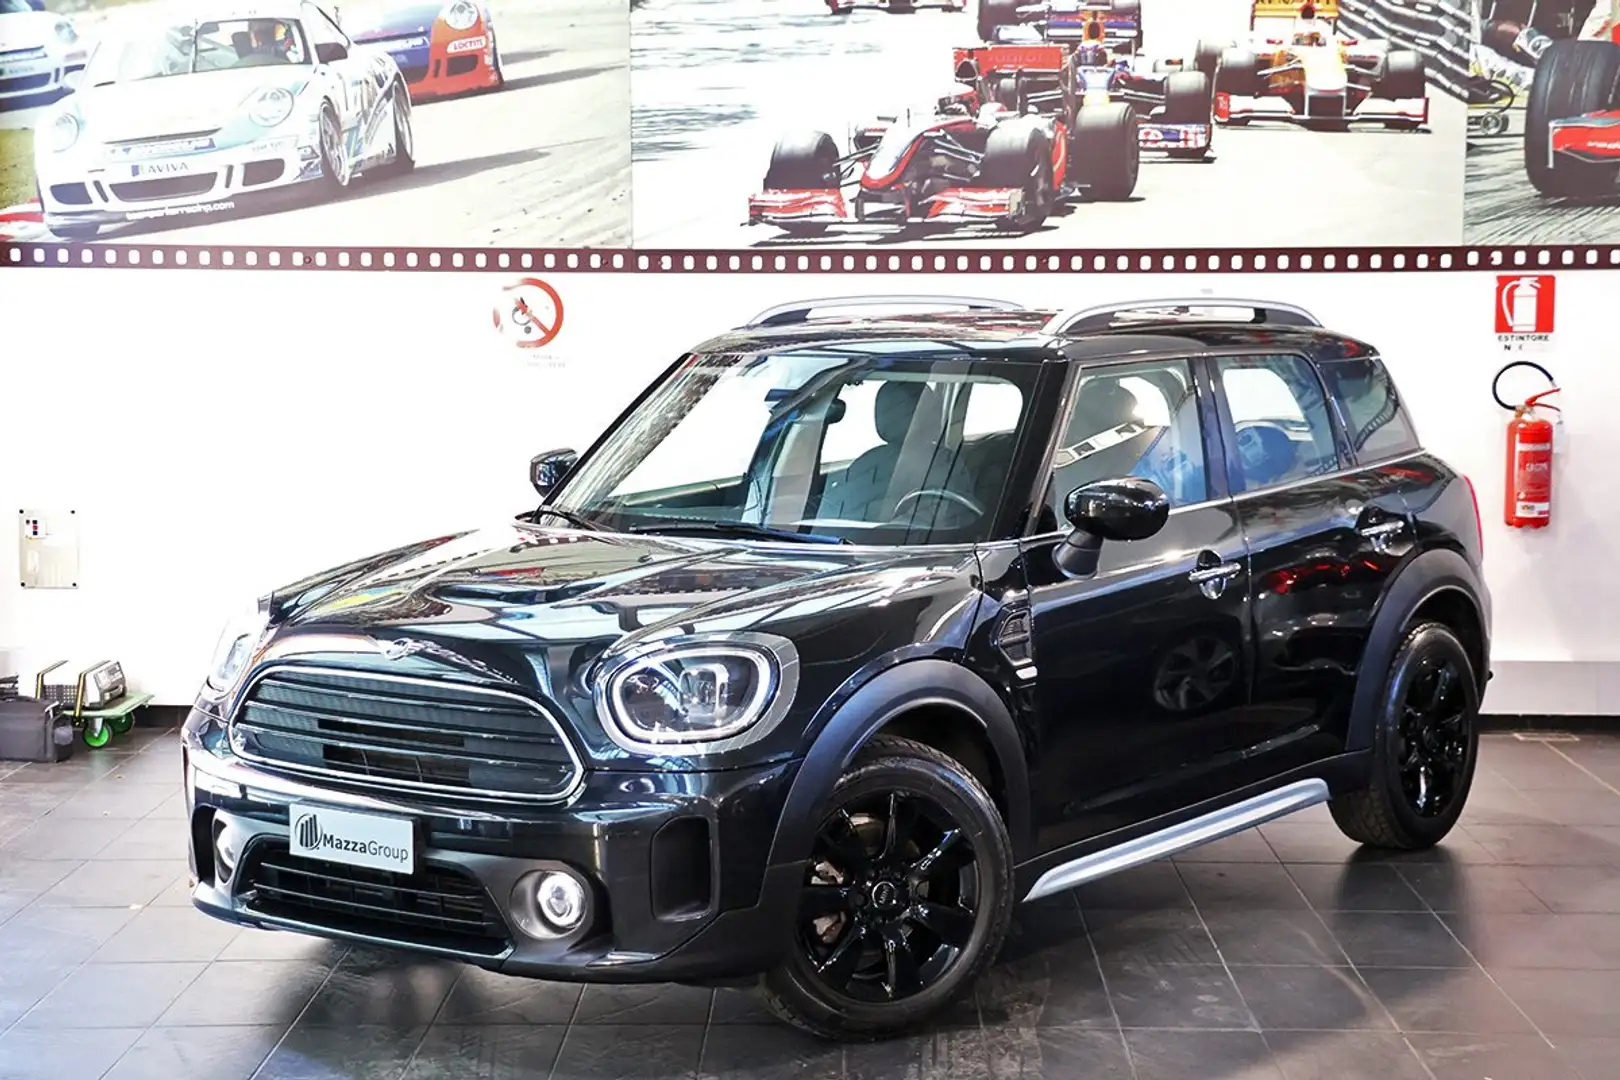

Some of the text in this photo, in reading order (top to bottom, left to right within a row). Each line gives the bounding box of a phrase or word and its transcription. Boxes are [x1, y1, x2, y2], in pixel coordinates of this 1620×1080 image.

[148, 162, 189, 174] AVIVA
[1497, 334, 1550, 342] ESTINTORE
[322, 833, 409, 863] MazzaGroup
